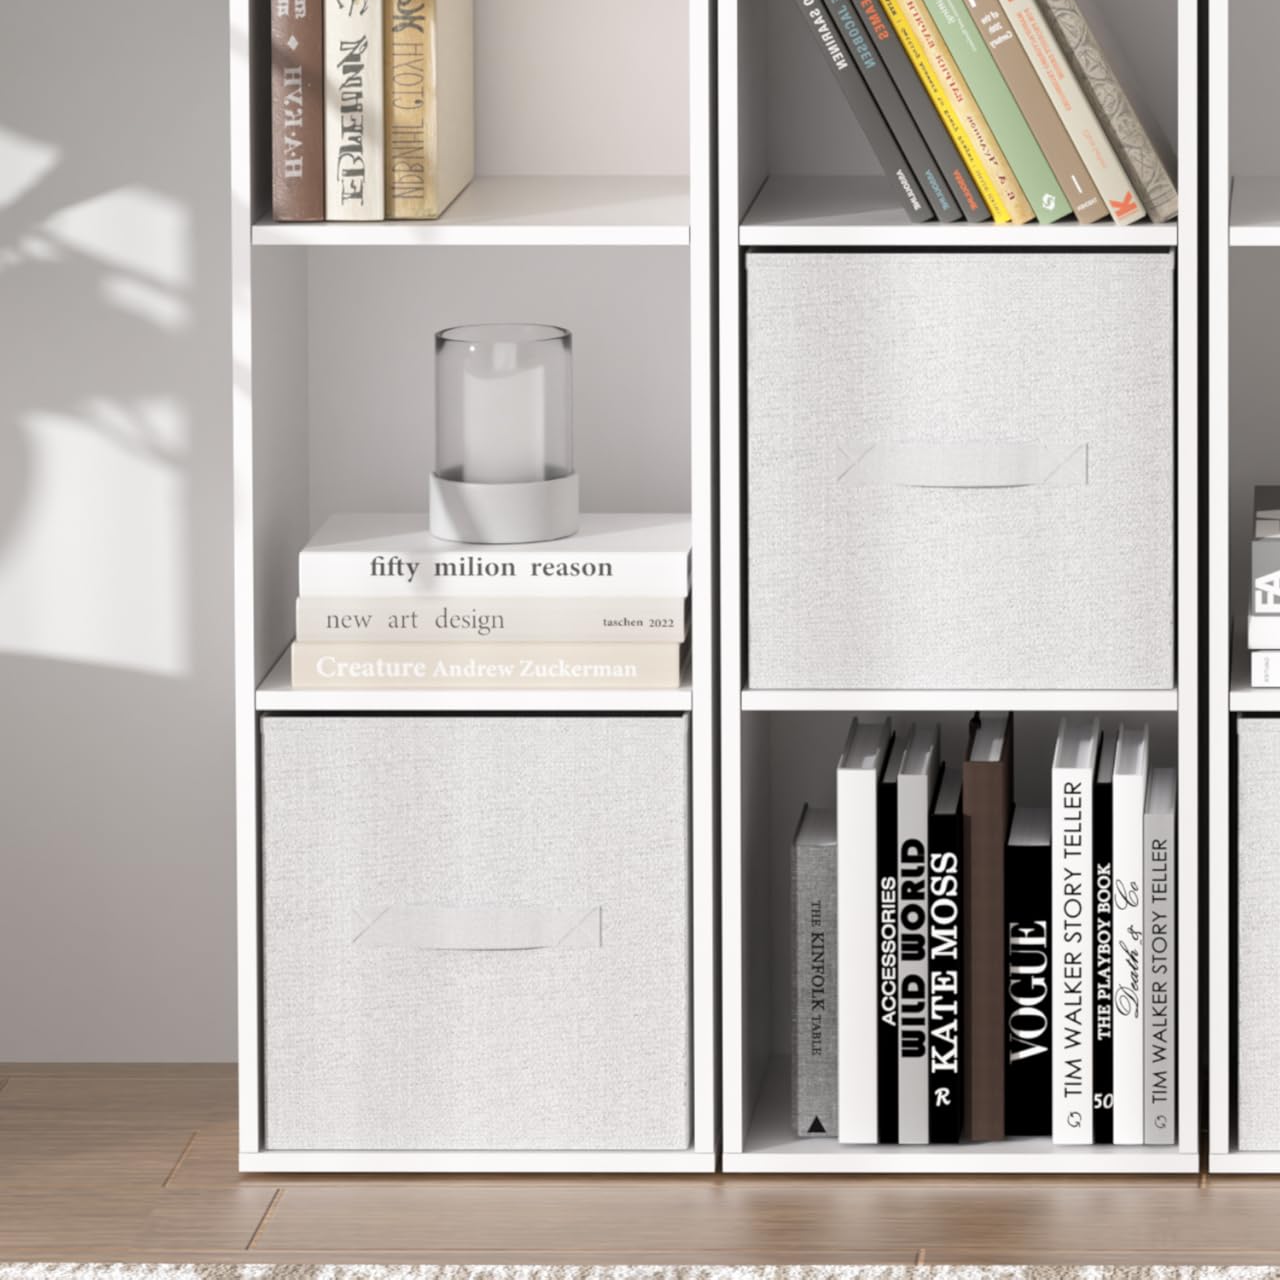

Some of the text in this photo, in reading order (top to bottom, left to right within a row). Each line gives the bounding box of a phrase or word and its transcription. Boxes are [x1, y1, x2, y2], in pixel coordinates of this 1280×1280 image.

[327, 609, 675, 635] new art design taschen 2022
[370, 556, 613, 581] fifty milion reason
[316, 656, 638, 678] Creature Andrew Zuckerman
[811, 900, 825, 1056] THE KINFOLK TABLE
[881, 877, 897, 1026] ACCESSORIES
[901, 838, 926, 1058] WILD WORLD
[931, 851, 958, 1075] KATE MOSS
[1009, 920, 1049, 1065] VOGUE
[1064, 781, 1082, 1098] TIM WALKER STORY TELLER
[1097, 863, 1112, 1041] THE PLAYBOY BOOK
[1115, 944, 1140, 1019] Death
[1152, 838, 1168, 1105] TIM WALKER STORY TELLER
